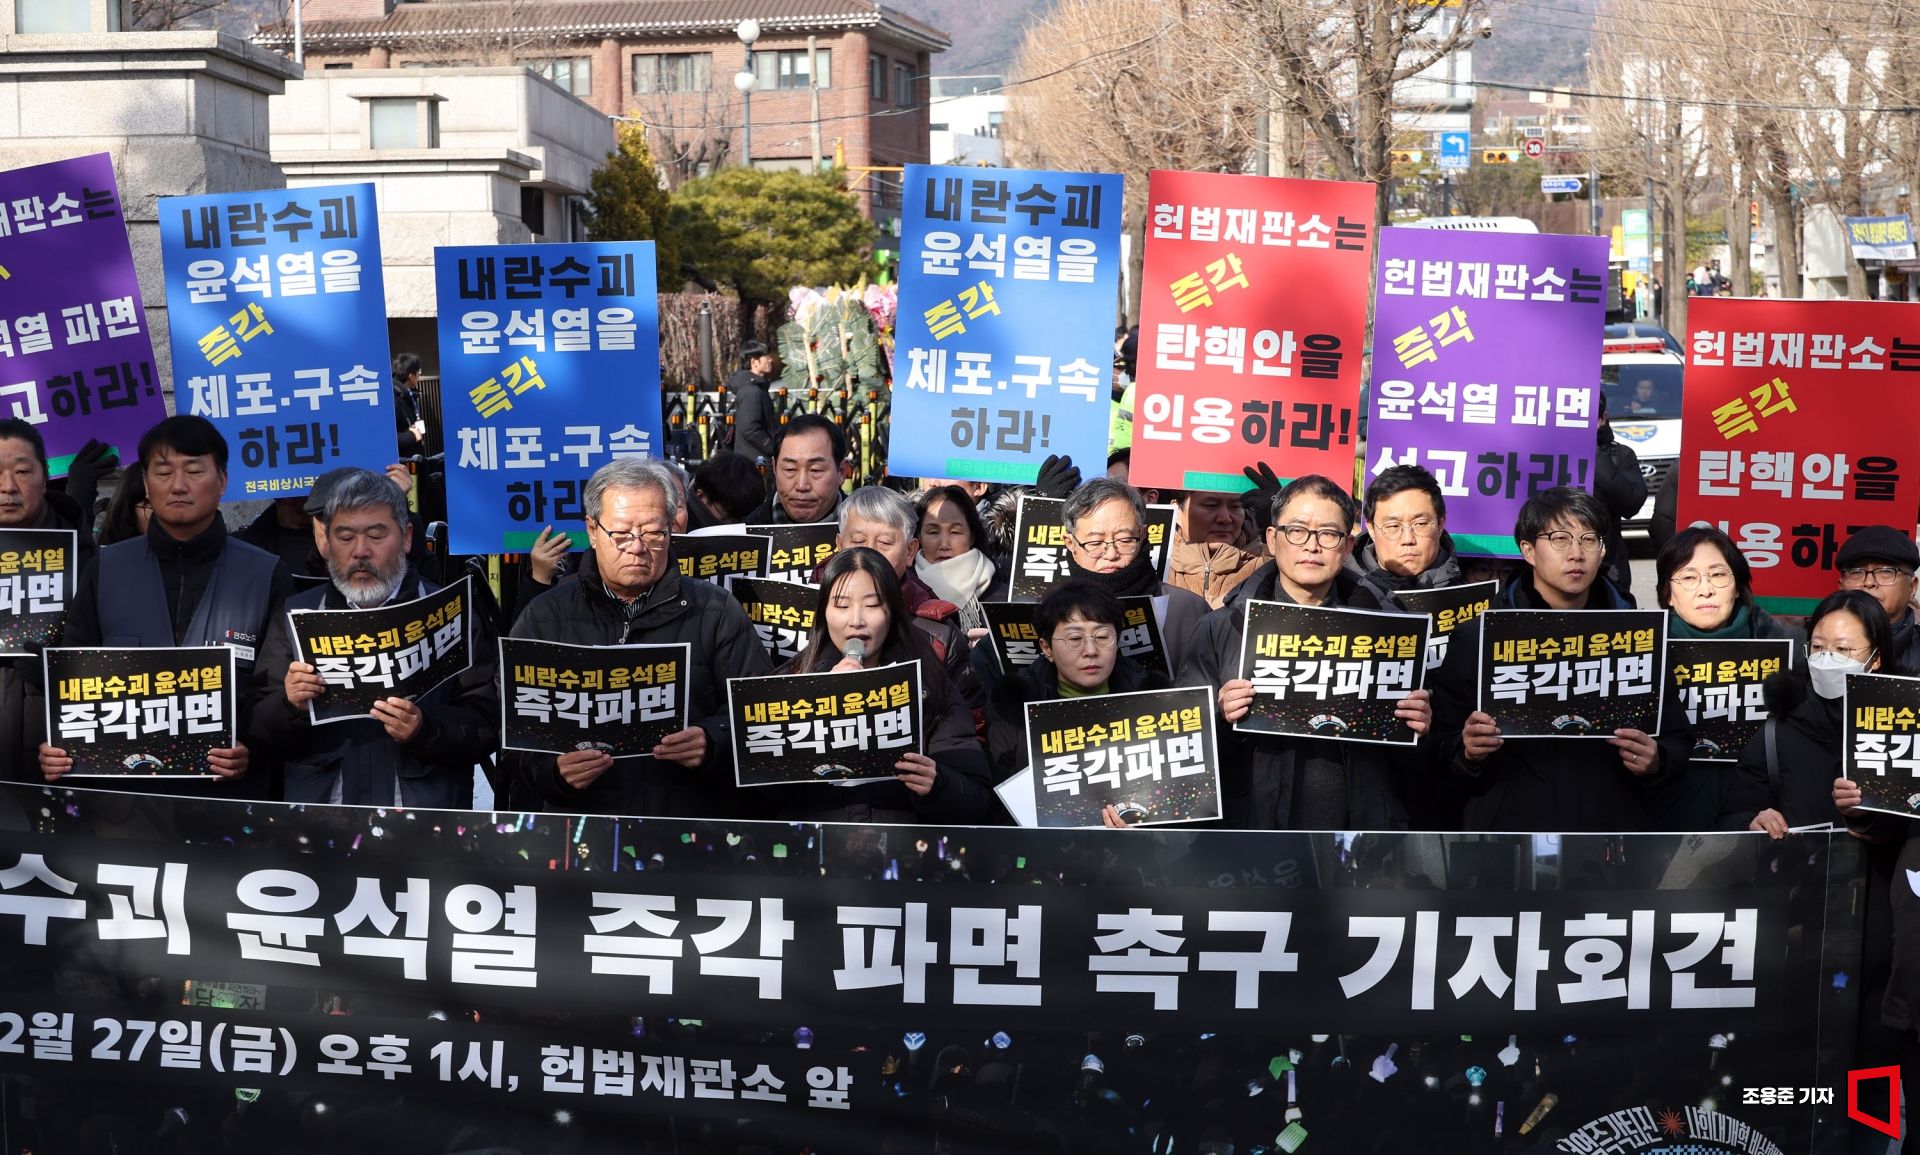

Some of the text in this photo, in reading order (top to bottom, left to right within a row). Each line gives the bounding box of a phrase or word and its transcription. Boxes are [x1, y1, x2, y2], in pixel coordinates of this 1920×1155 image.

[1529, 143, 1540, 154] 30
[182, 195, 358, 249] 내란수괴
[924, 177, 1102, 229] 내란수괴
[1153, 203, 1367, 252] 헌법재판소는
[186, 249, 362, 304] 윤석열을
[458, 252, 635, 301] 내란수괴
[921, 231, 1098, 283] 윤석열을
[1384, 257, 1602, 303] 헌법재판소는
[1170, 252, 1250, 314] 즉각
[62, 296, 140, 346] 파면
[197, 302, 274, 368] 즉각
[459, 306, 638, 355] 윤석열을
[924, 280, 1003, 341] 즉각
[1155, 322, 1343, 381] 탄핵안을
[1392, 305, 1475, 370] 즉각
[1692, 329, 1920, 373] 헌법재판소는
[188, 365, 380, 420] 체포.구속
[469, 355, 547, 420] 즉각
[906, 347, 1101, 402] 체포.구속
[1142, 392, 1351, 452] 인용하라!
[1377, 379, 1591, 429] 윤석열 파면
[1712, 377, 1798, 441] 즉각
[239, 423, 341, 469] 하라!
[457, 424, 650, 471] 체포.구속
[950, 407, 1051, 454] 하라!
[245, 475, 319, 493] 전국비상시국
[1698, 449, 1900, 502] 탄핵안을
[0, 548, 65, 574] 윤석열
[699, 549, 759, 576] 윤석열
[772, 545, 810, 570] 수괴
[1688, 520, 1908, 571] 용하
[310, 595, 463, 656] 내란수괴 윤석열
[1256, 632, 1346, 659] 내란수괴
[1351, 634, 1417, 661] 윤석열
[1493, 628, 1655, 663] 내란수괴 윤석열
[315, 617, 463, 690] 즉각파면
[515, 660, 676, 690] 내란수괴 윤석열
[1716, 657, 1780, 684] 윤석열
[59, 665, 222, 702] 내란수괴 윤석열
[744, 680, 910, 724] 내란수괴 윤석열
[1250, 659, 1415, 701] 즉각파면
[1490, 655, 1653, 705] 즉각파면
[58, 691, 223, 744] 즉각파면
[513, 683, 676, 729] 즉각파면
[1041, 705, 1203, 756] 내란수괴 윤석열
[1856, 706, 1920, 732] 내란수
[745, 706, 914, 757] 즉각파면
[1042, 732, 1206, 796] 즉각파면
[0, 853, 1759, 1011] 수괴 윤석열 즉각 파면 촉구 기자회견
[0, 1011, 853, 1111] 2월 27일(금) 오후 1시, 헌법재판소 앞
